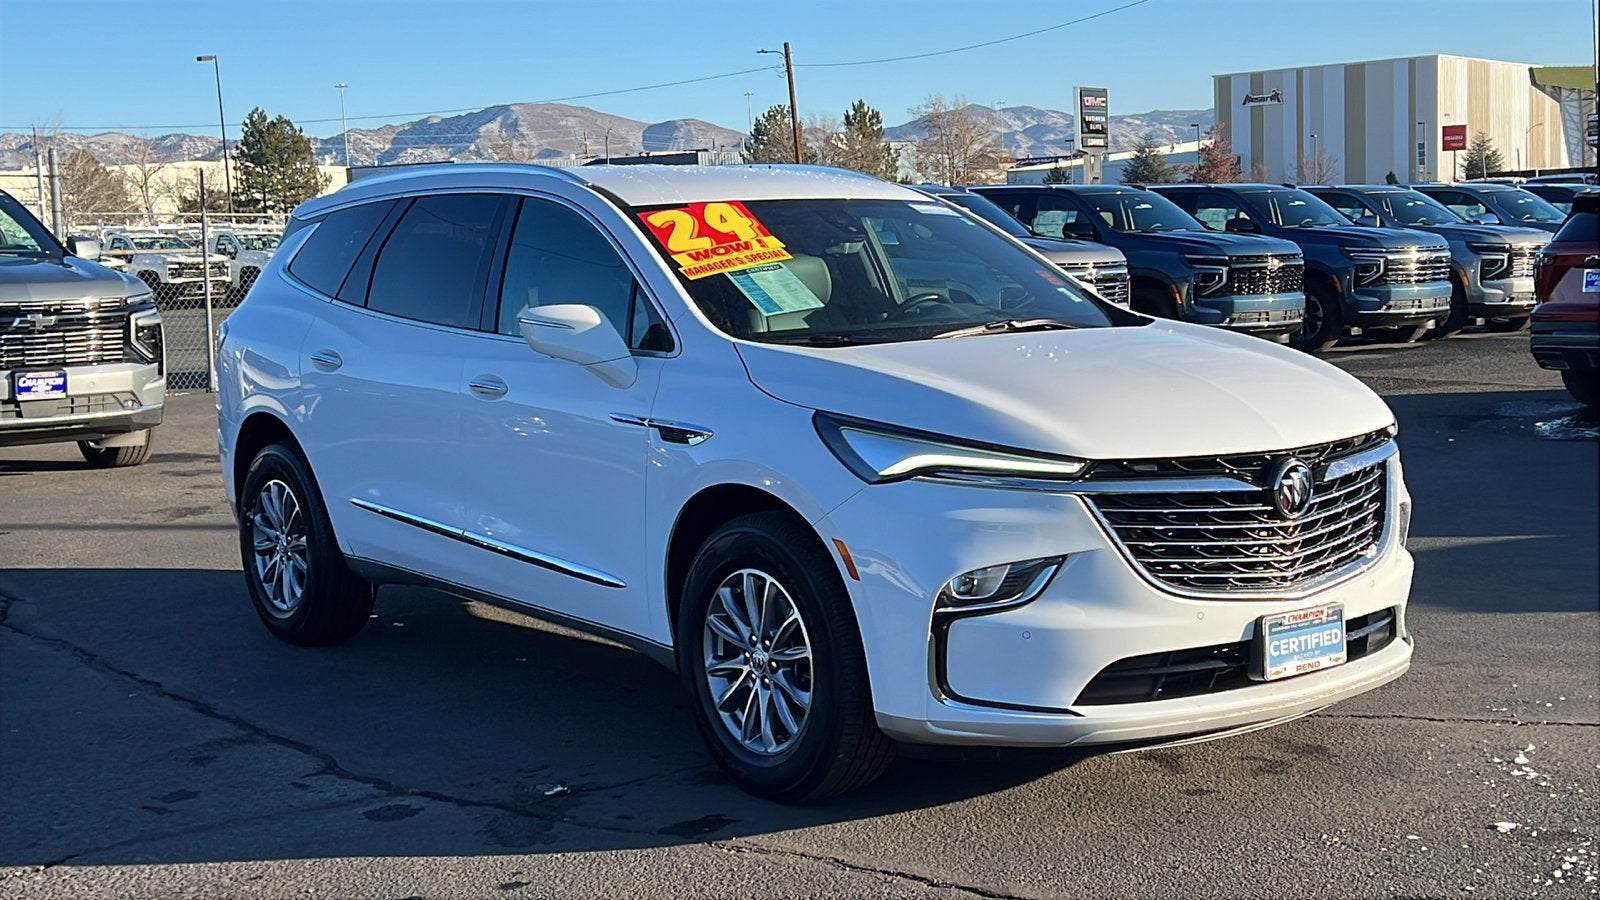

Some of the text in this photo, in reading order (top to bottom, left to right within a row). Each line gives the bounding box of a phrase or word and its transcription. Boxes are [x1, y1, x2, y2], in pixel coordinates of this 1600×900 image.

[647, 202, 760, 253] 24
[686, 241, 752, 262] WOW
[683, 249, 787, 278] MANAGER'S SPECIAL
[18, 377, 64, 387] CHAMPION
[1288, 609, 1324, 622] CHAMPION
[1269, 628, 1341, 657] CERTIFIED
[1296, 661, 1321, 672] RENO
